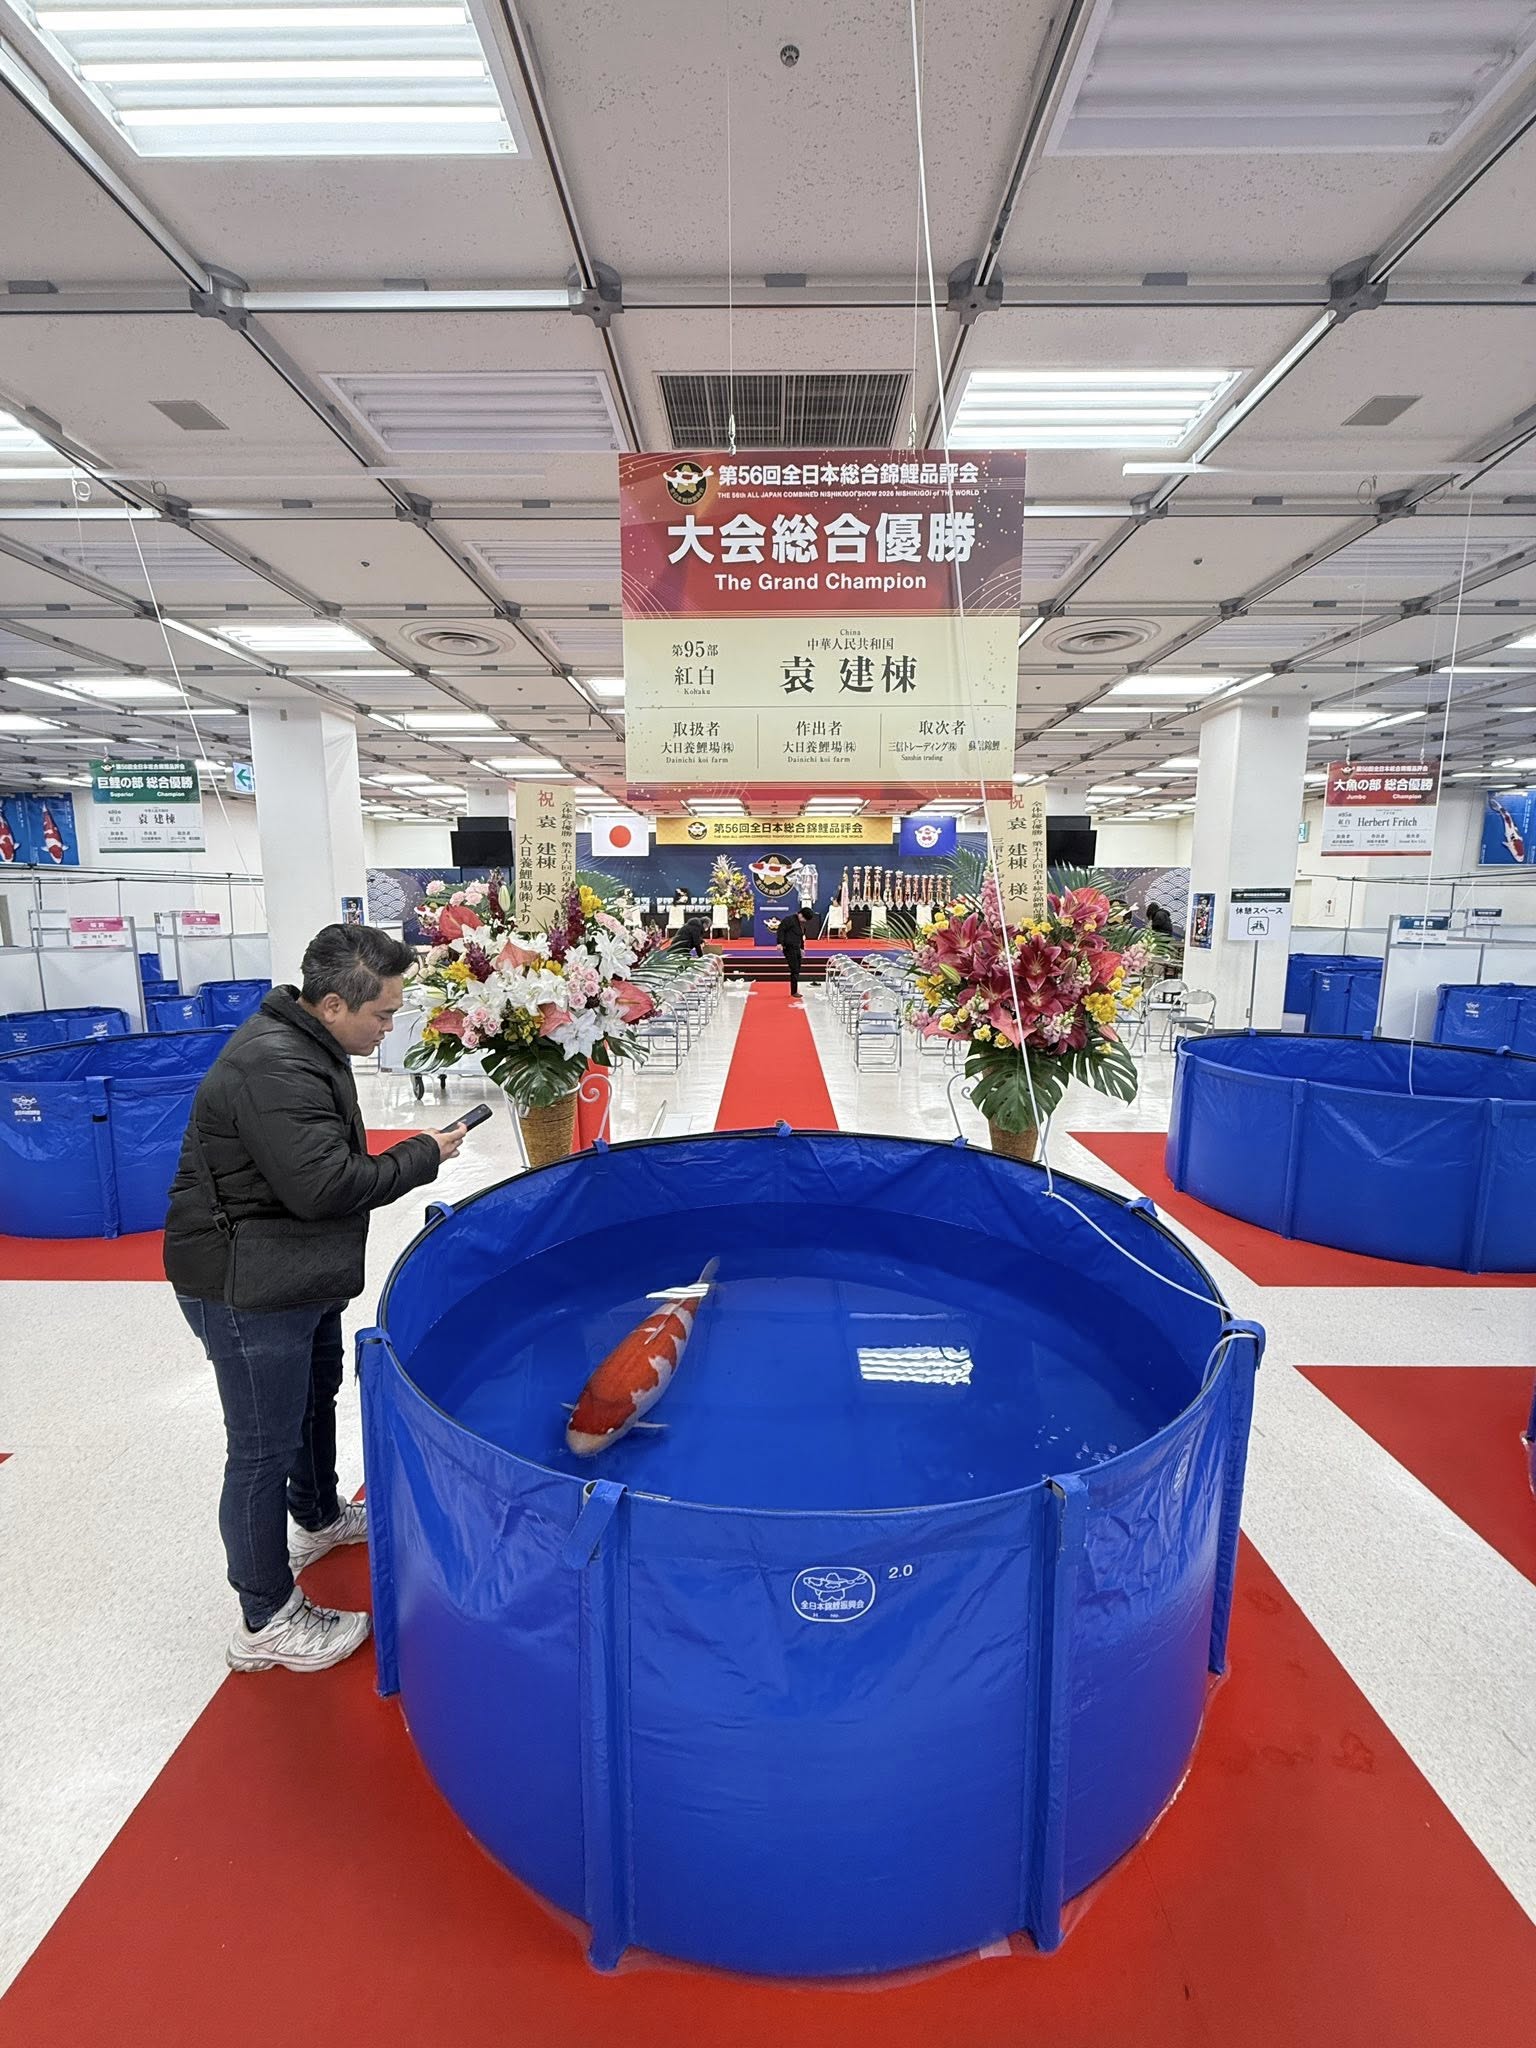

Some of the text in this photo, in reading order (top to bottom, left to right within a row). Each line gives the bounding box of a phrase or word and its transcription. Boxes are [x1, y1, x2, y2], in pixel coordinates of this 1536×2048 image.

[718, 462, 980, 486] 第56回全日本総合錦鯉品評会
[667, 512, 977, 564] 大会総合優勝
[714, 572, 927, 593] The Grand Champion
[840, 628, 861, 636] China
[672, 640, 719, 658] 第95部
[807, 637, 894, 651] 中華人民共和国
[675, 665, 714, 686] 紅白
[779, 655, 917, 694] 袁 建棟
[673, 721, 720, 737] 取扱者
[796, 720, 843, 737] 作出者
[919, 719, 966, 736] 取次者
[666, 756, 729, 764] Dainichi koi farm
[787, 755, 851, 763] Dainichi koi farm
[146, 776, 194, 789] 総合優勝
[1333, 778, 1433, 791] 大魚の部 総合優勝
[538, 790, 555, 807] 祝
[1008, 794, 1025, 810] 祝
[714, 822, 863, 834] 第56回全日本総合錦鯉品評会
[1357, 816, 1417, 827] Herbert Fritch
[536, 882, 557, 903] 様へ
[1008, 882, 1029, 902] 様へ
[888, 1564, 913, 1580] 2.0
